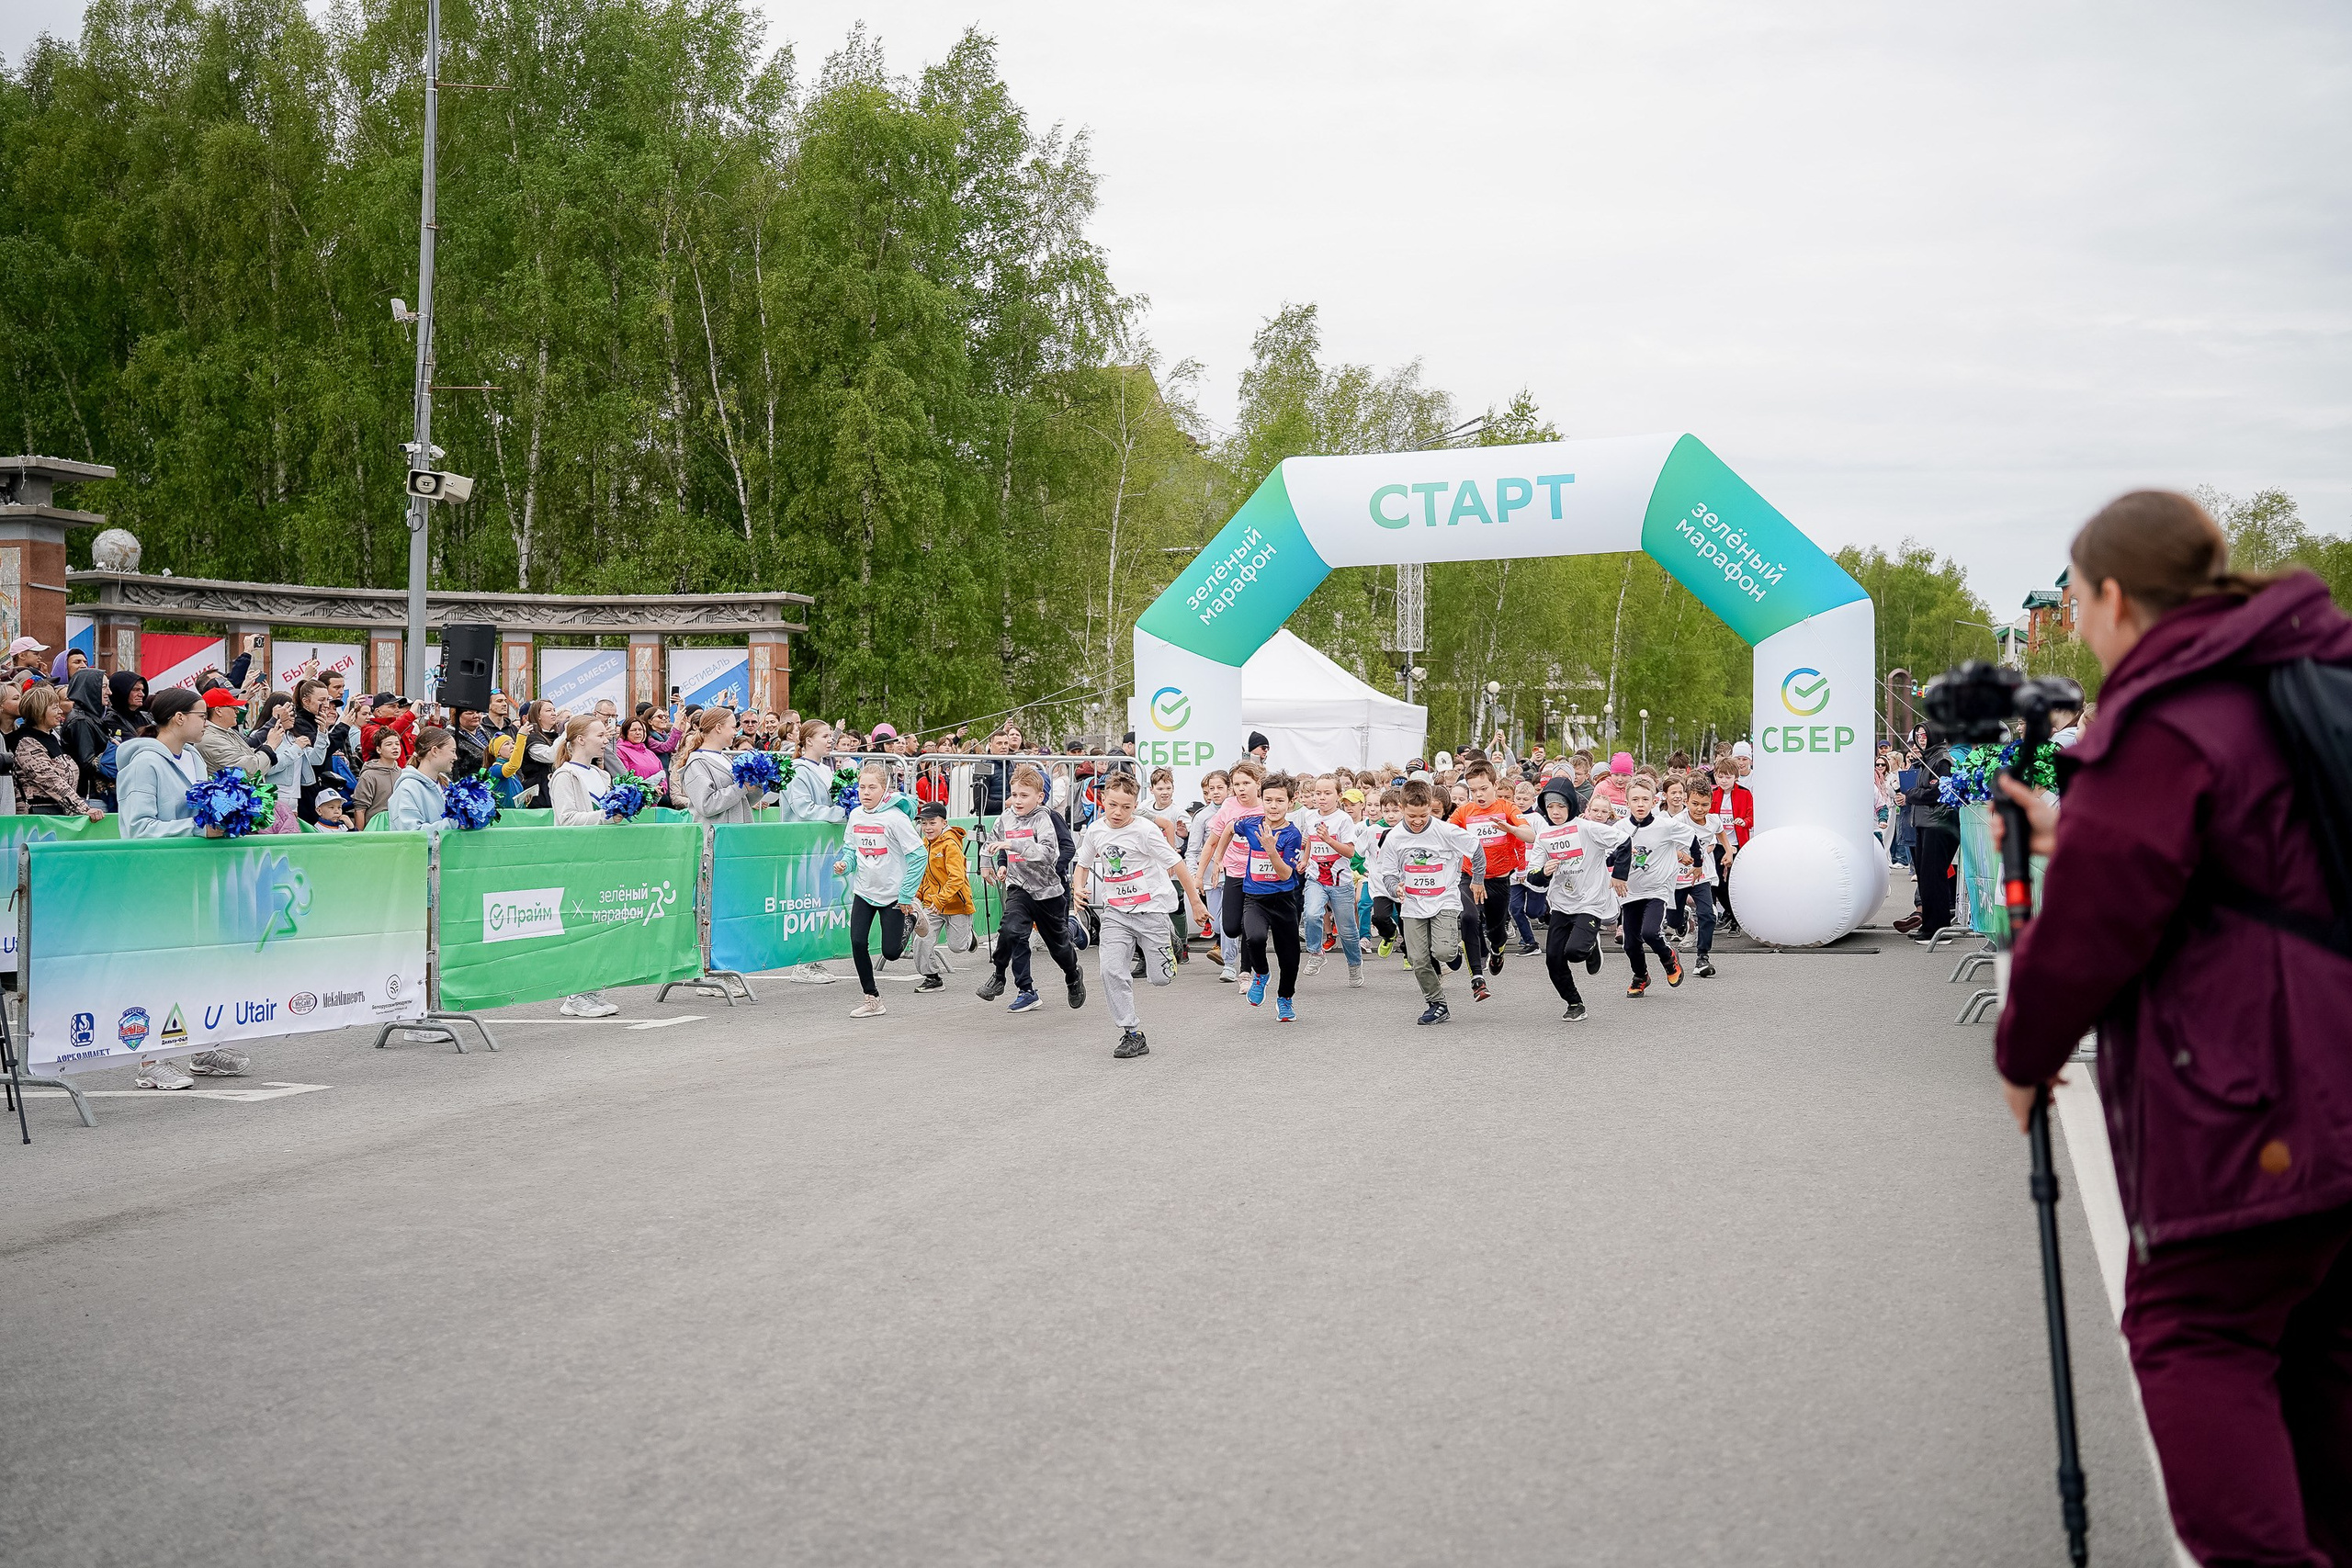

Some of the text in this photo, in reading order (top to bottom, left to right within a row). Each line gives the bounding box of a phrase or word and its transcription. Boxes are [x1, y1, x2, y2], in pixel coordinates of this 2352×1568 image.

[1369, 473, 1575, 529] СТАРТ
[1690, 502, 1788, 586] зелёный
[1186, 525, 1262, 610] зелёный
[1675, 518, 1767, 603] марафон
[1199, 543, 1278, 626] марафон
[547, 657, 619, 700] БЫТЬ ВМЕСТЕ
[1138, 740, 1215, 766] СБЕР
[1761, 726, 1855, 753] СБЕР
[1476, 827, 1498, 836] 2663
[598, 882, 649, 903] зелёный
[1116, 885, 1138, 895] 2646
[1413, 878, 1435, 886] 2758
[506, 901, 552, 928] Прайм
[592, 903, 644, 926] марафон
[764, 893, 821, 913] В твоём
[783, 908, 851, 941] ритм
[236, 998, 277, 1025] Utair
